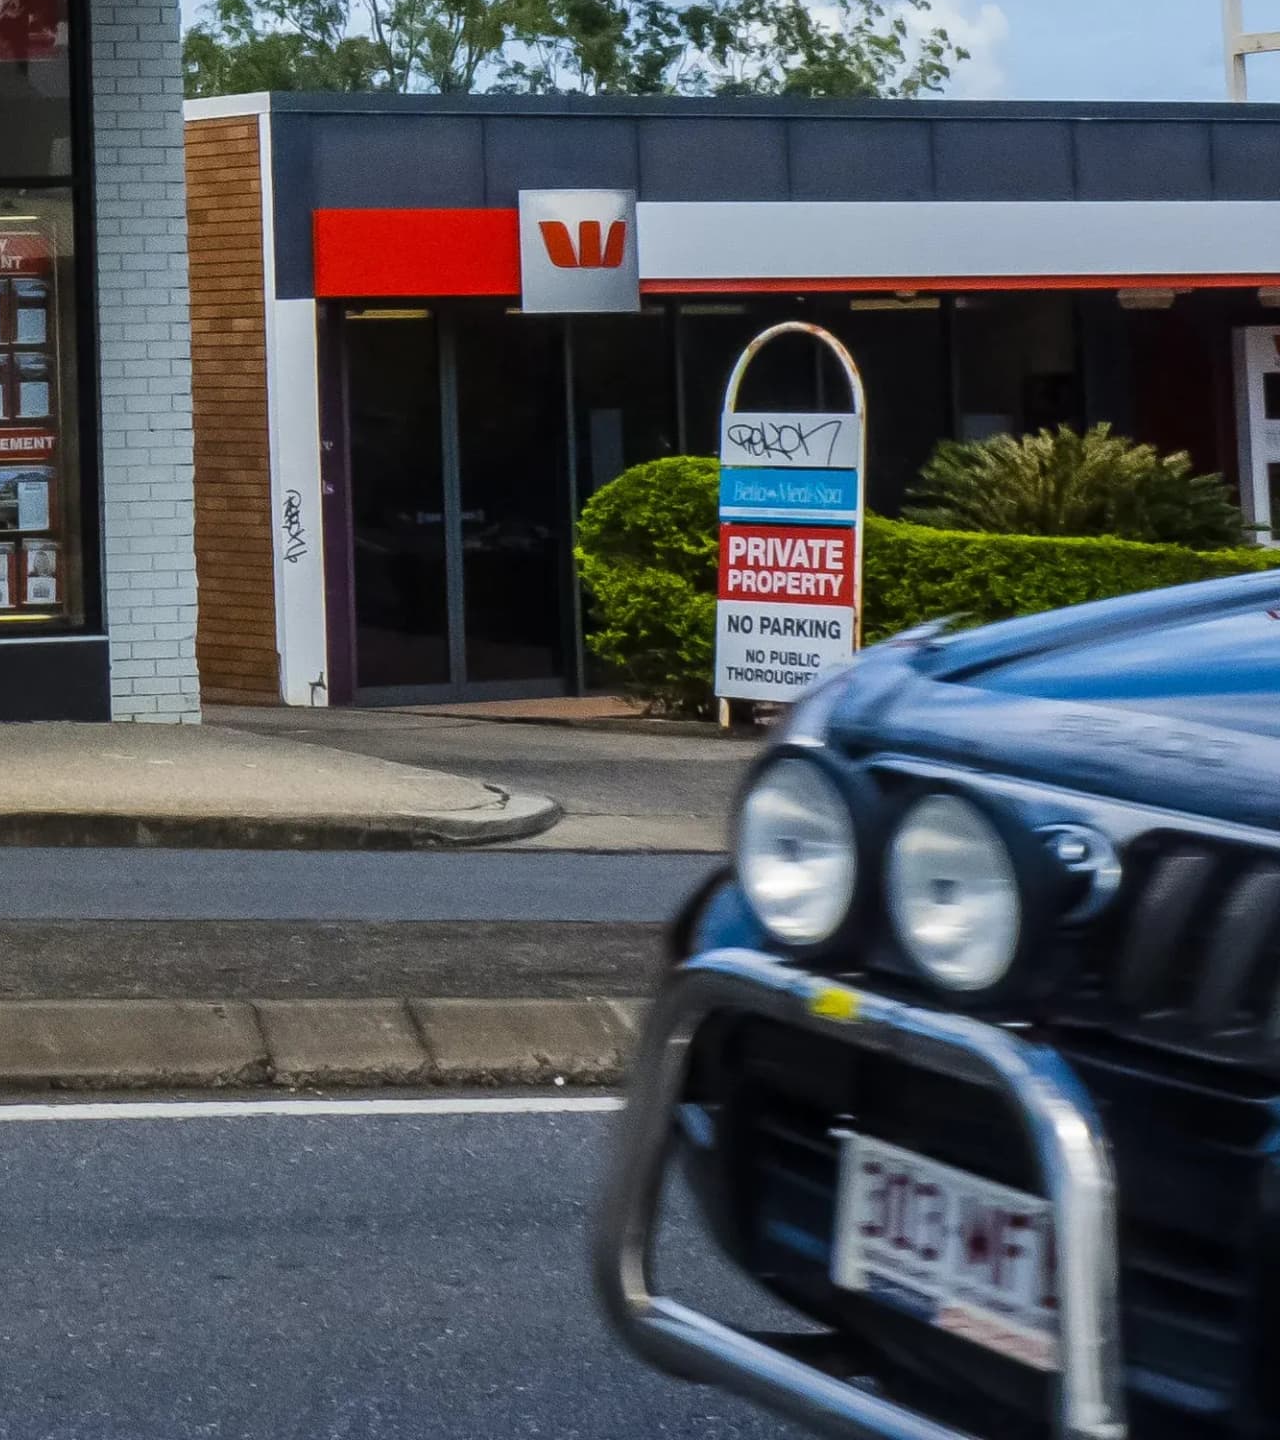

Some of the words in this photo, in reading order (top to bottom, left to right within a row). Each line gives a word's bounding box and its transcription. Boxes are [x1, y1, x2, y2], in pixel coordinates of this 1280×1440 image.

[728, 535, 844, 570] PRIVATE
[728, 570, 844, 597] PROPERTY
[728, 615, 752, 635] NO
[760, 617, 841, 640] PARKING
[745, 649, 765, 663] NO
[770, 650, 820, 668] PUBLIC
[726, 666, 817, 686] THOROUGHF
